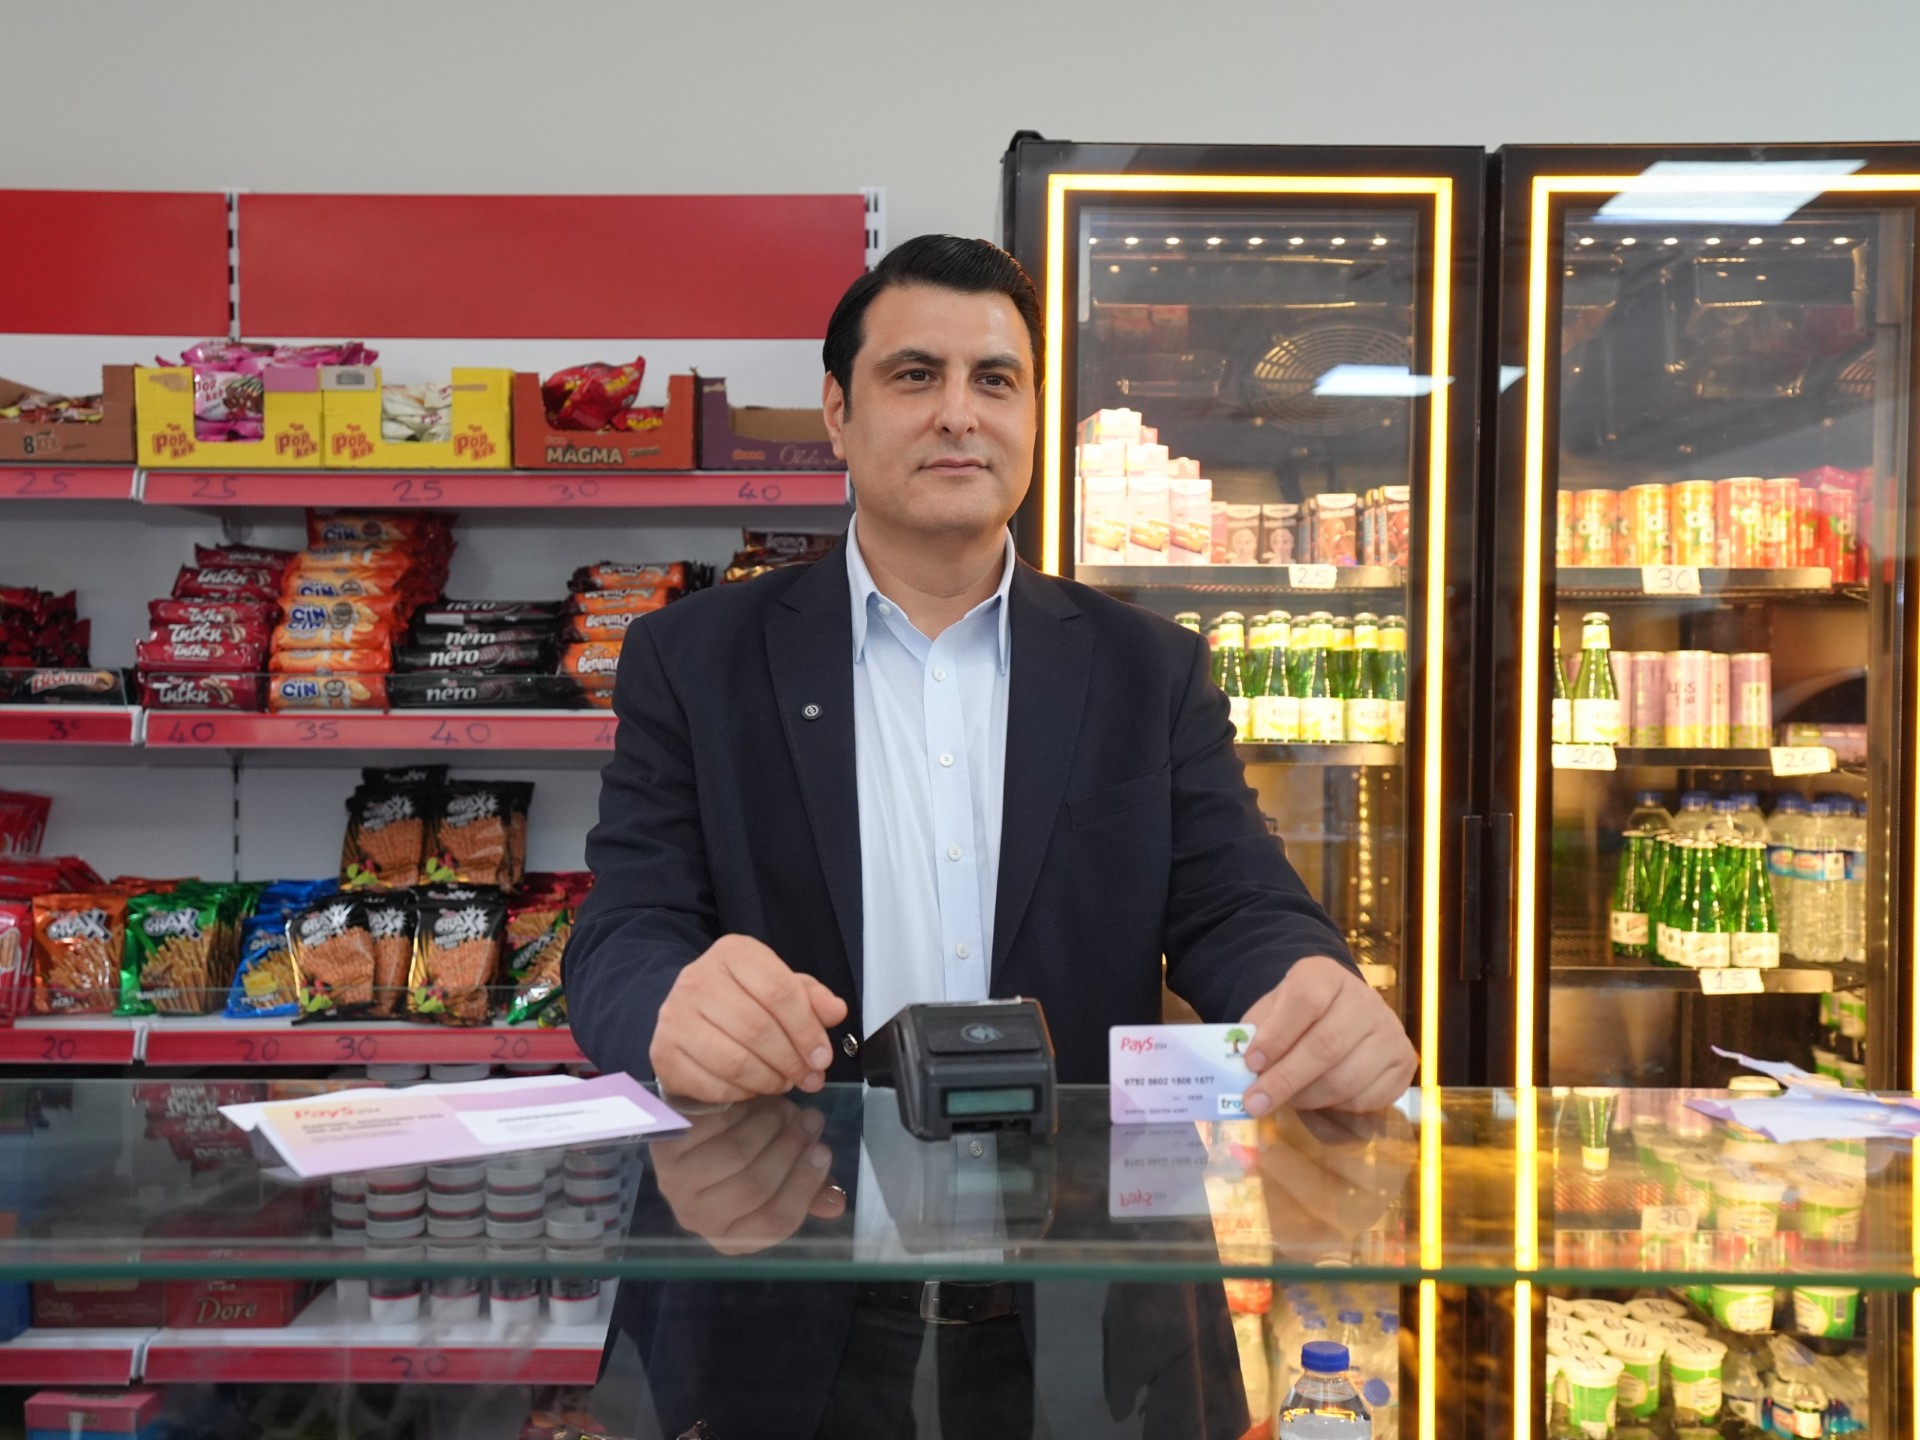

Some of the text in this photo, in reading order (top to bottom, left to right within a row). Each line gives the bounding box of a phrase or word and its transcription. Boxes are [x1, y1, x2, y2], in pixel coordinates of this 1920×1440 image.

[546, 446, 624, 464] MAGMA
[16, 470, 76, 495] 25
[192, 476, 238, 499] 25
[392, 479, 443, 502] 25
[550, 479, 599, 501] 30
[738, 481, 781, 502] 40
[1297, 566, 1329, 585] 25
[1656, 567, 1693, 591] 30
[168, 621, 223, 643] Tutku
[429, 650, 480, 667] nero
[152, 680, 211, 703] Tutku
[426, 686, 478, 702] nero
[167, 721, 215, 744] 40
[296, 721, 339, 741] 35
[431, 720, 491, 745] 40
[1571, 748, 1606, 766] 20
[1785, 752, 1817, 768] 25
[1714, 971, 1746, 990] 15
[42, 1036, 77, 1061] 20
[236, 1038, 280, 1063] 20
[335, 1036, 379, 1061] 30
[490, 1035, 530, 1060] 20
[197, 1297, 259, 1325] Dore
[390, 1353, 450, 1378] 20
